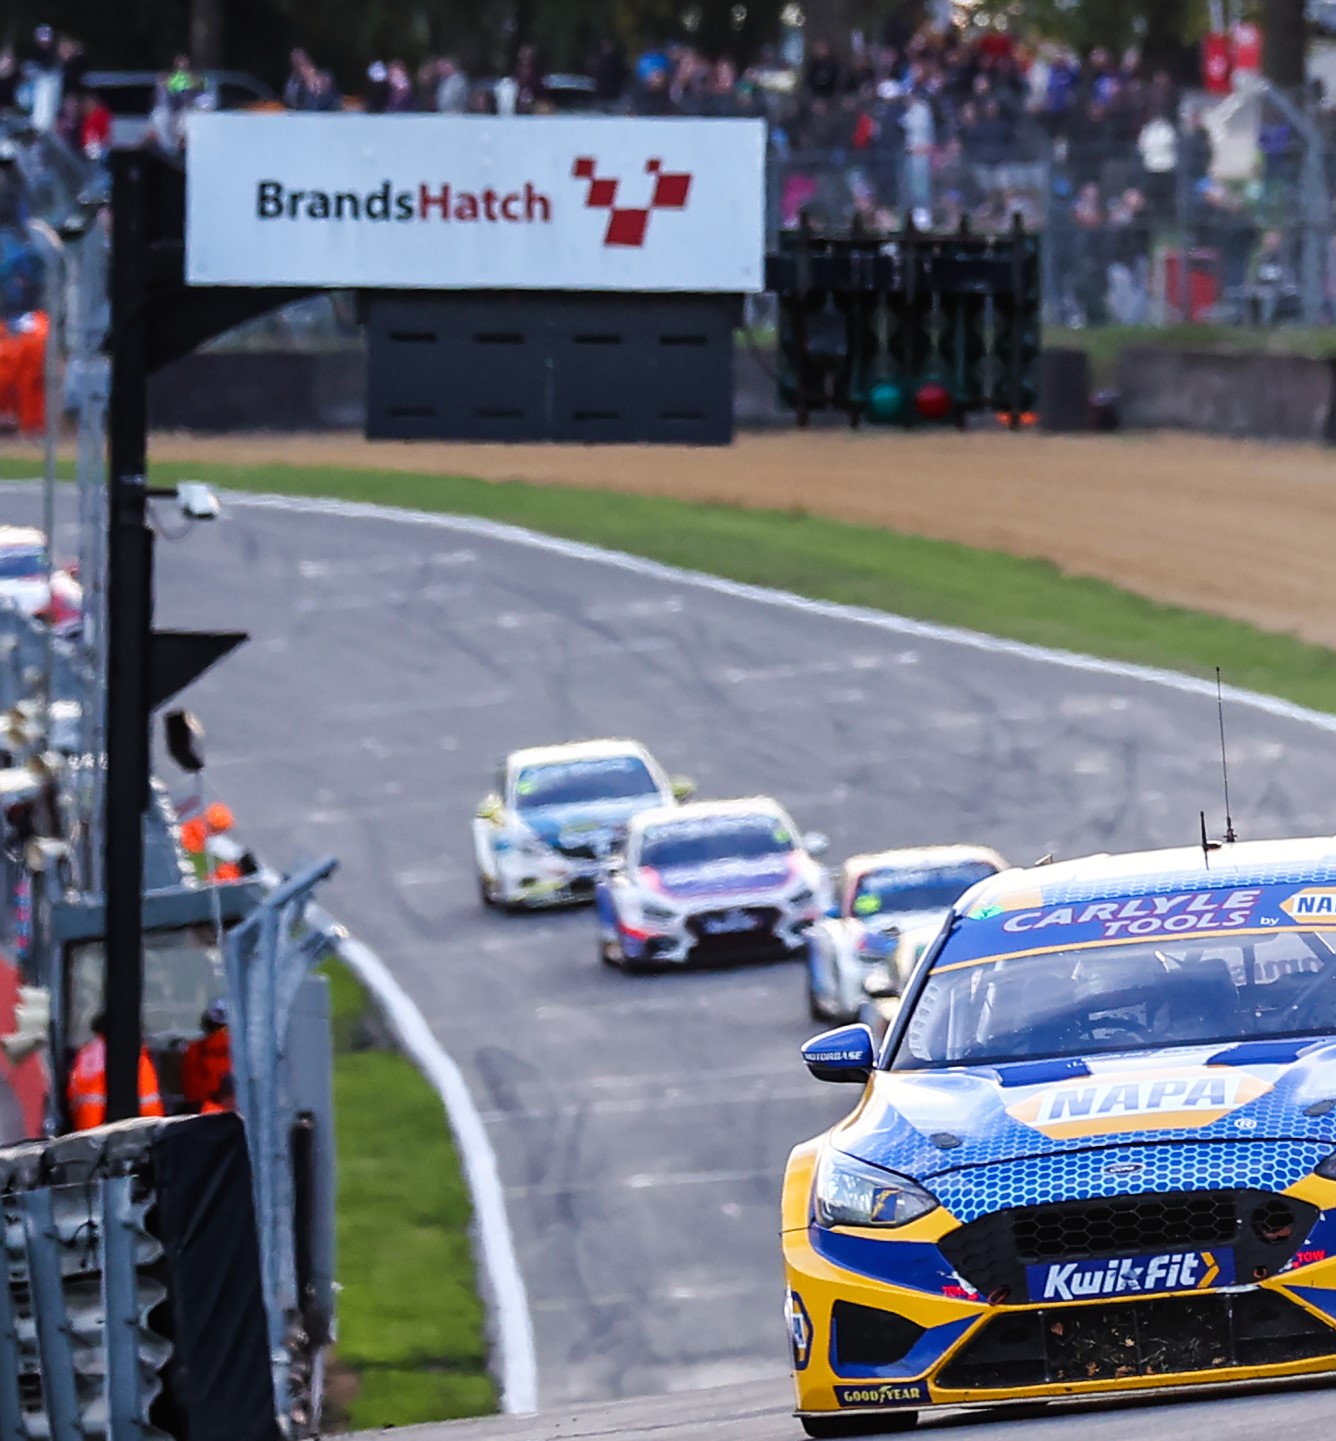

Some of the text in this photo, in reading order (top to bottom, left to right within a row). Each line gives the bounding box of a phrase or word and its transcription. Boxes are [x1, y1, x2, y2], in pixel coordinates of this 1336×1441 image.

[256, 180, 552, 223] BrandsHatch
[1003, 890, 1261, 932] CARLYLE
[1104, 910, 1280, 936] TOOLS by
[1048, 1078, 1227, 1120] NAPA
[843, 1387, 920, 1402] GOODYEAR
